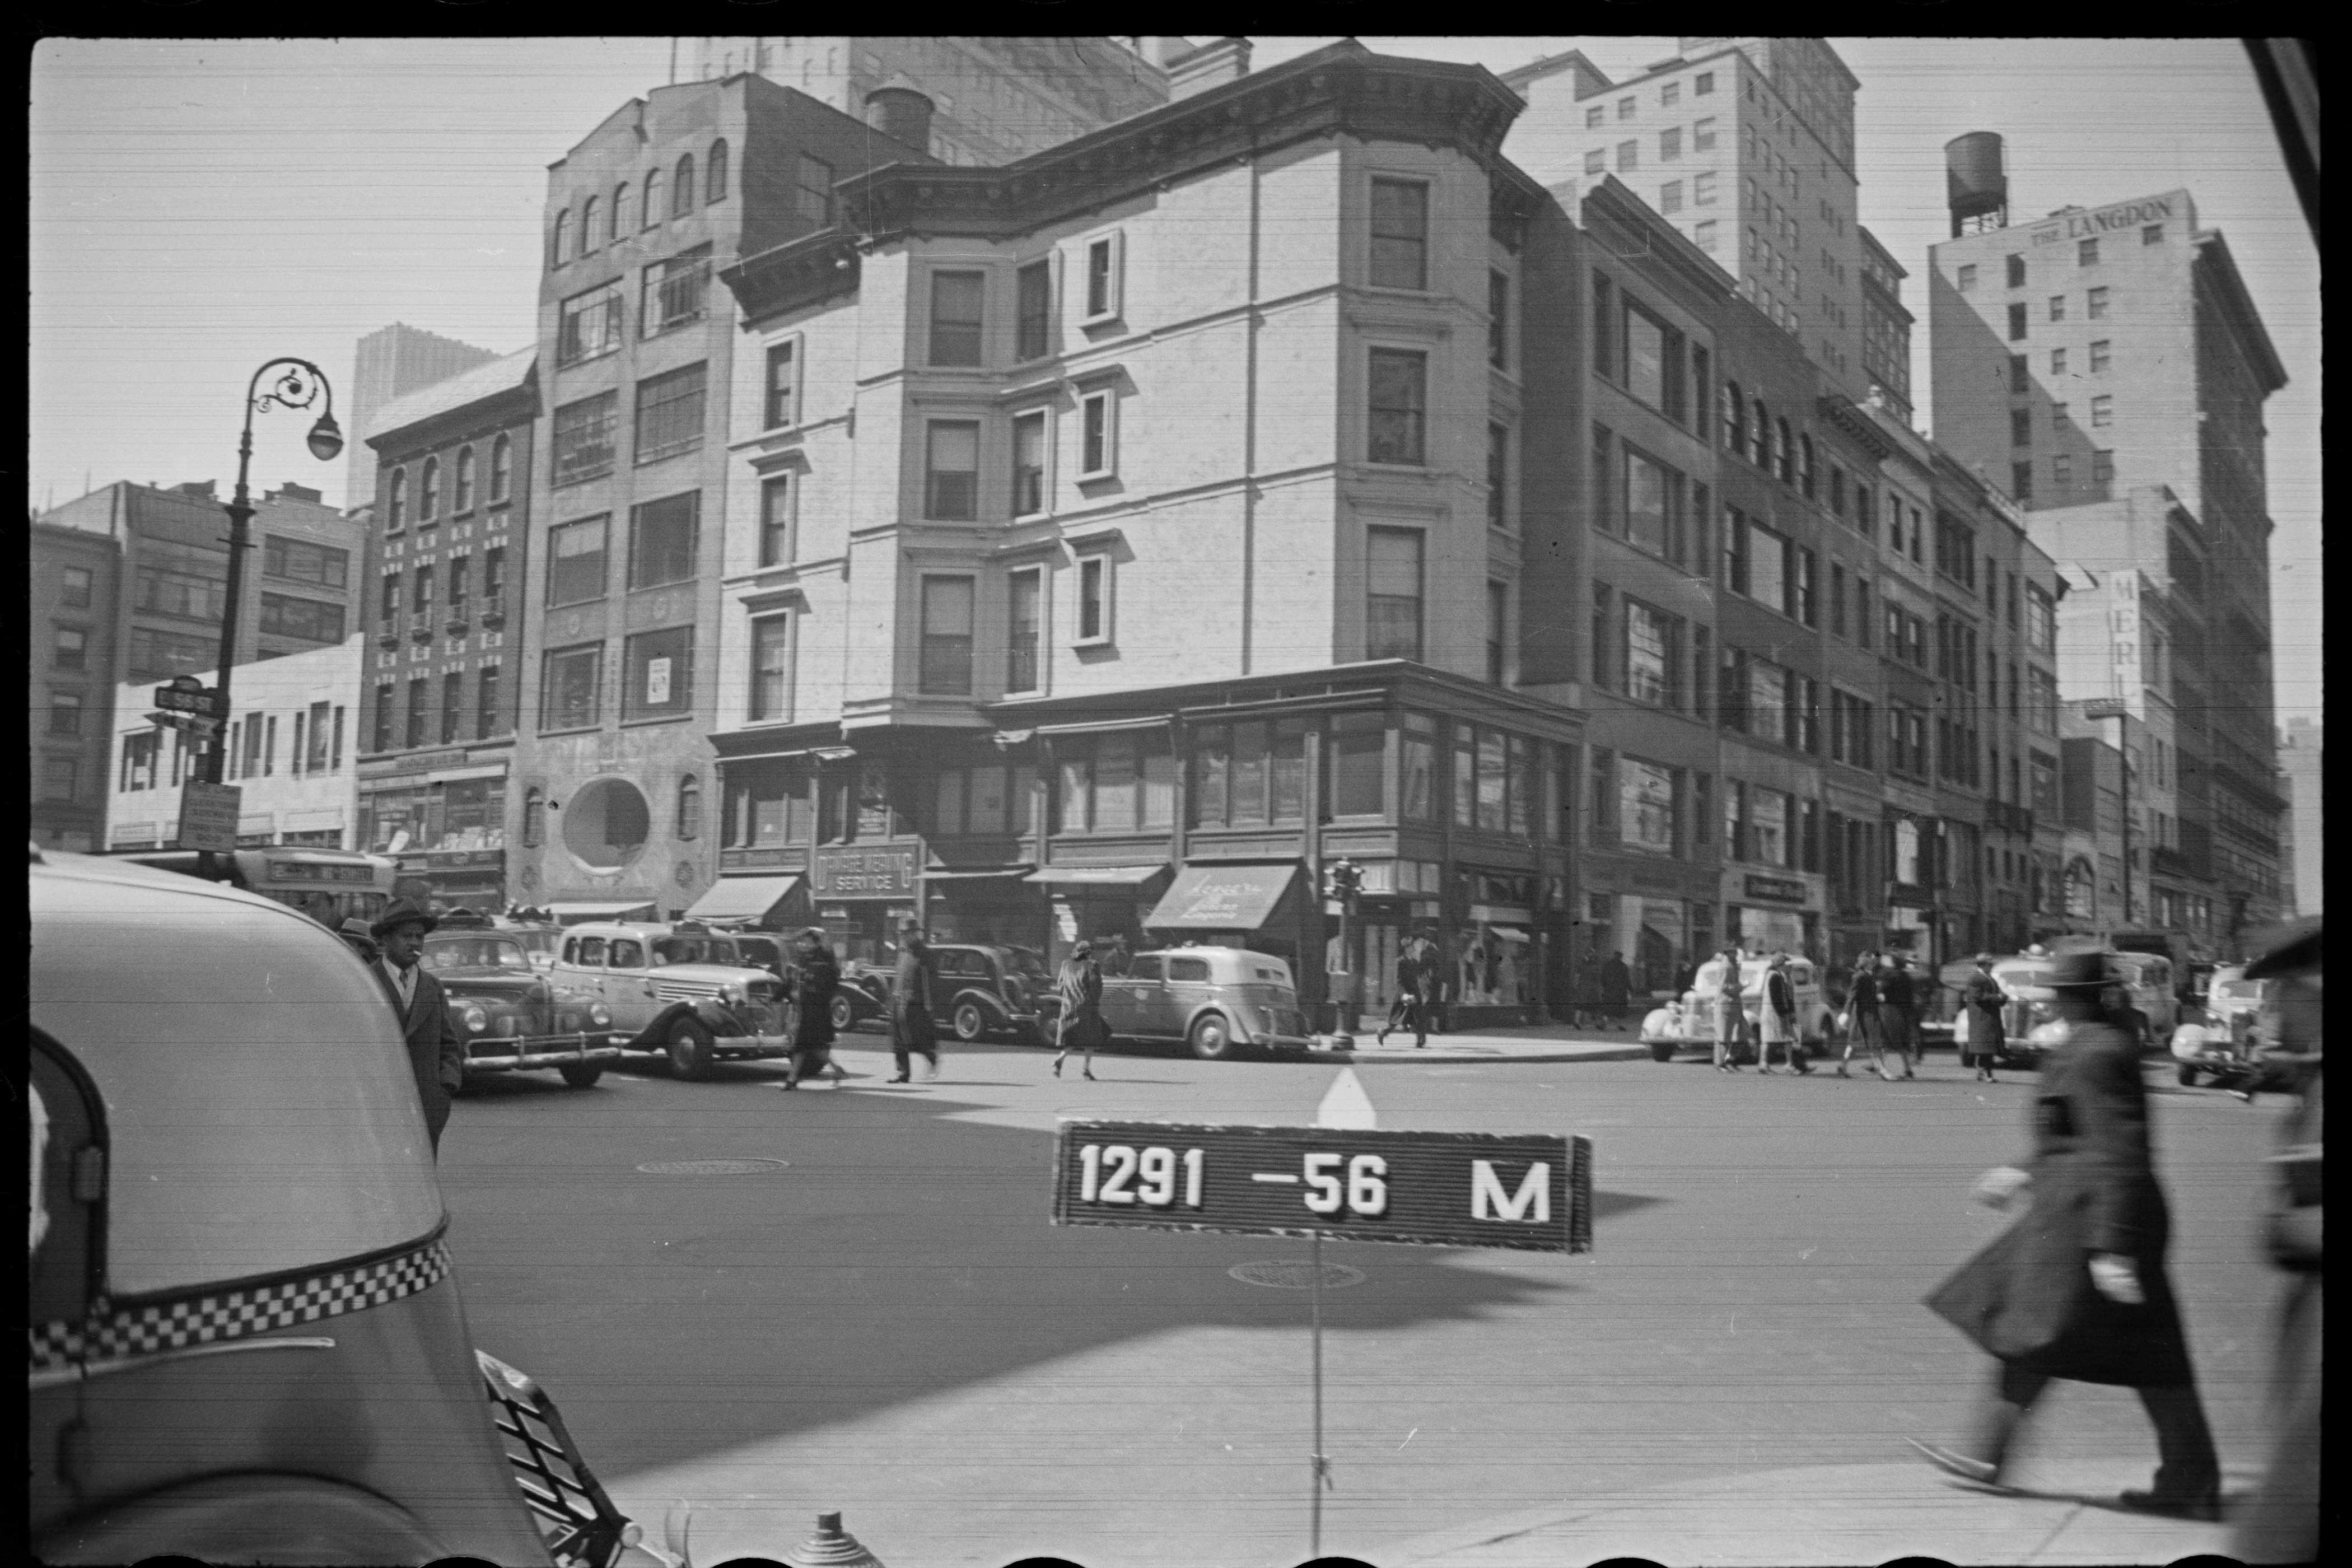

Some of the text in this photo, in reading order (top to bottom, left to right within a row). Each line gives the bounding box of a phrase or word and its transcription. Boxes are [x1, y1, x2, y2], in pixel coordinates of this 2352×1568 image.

[2030, 197, 2172, 246] THE LANGDON
[836, 875, 893, 890] SERVICE
[1080, 1144, 1204, 1207] 1291
[1471, 1159, 1550, 1222] M
